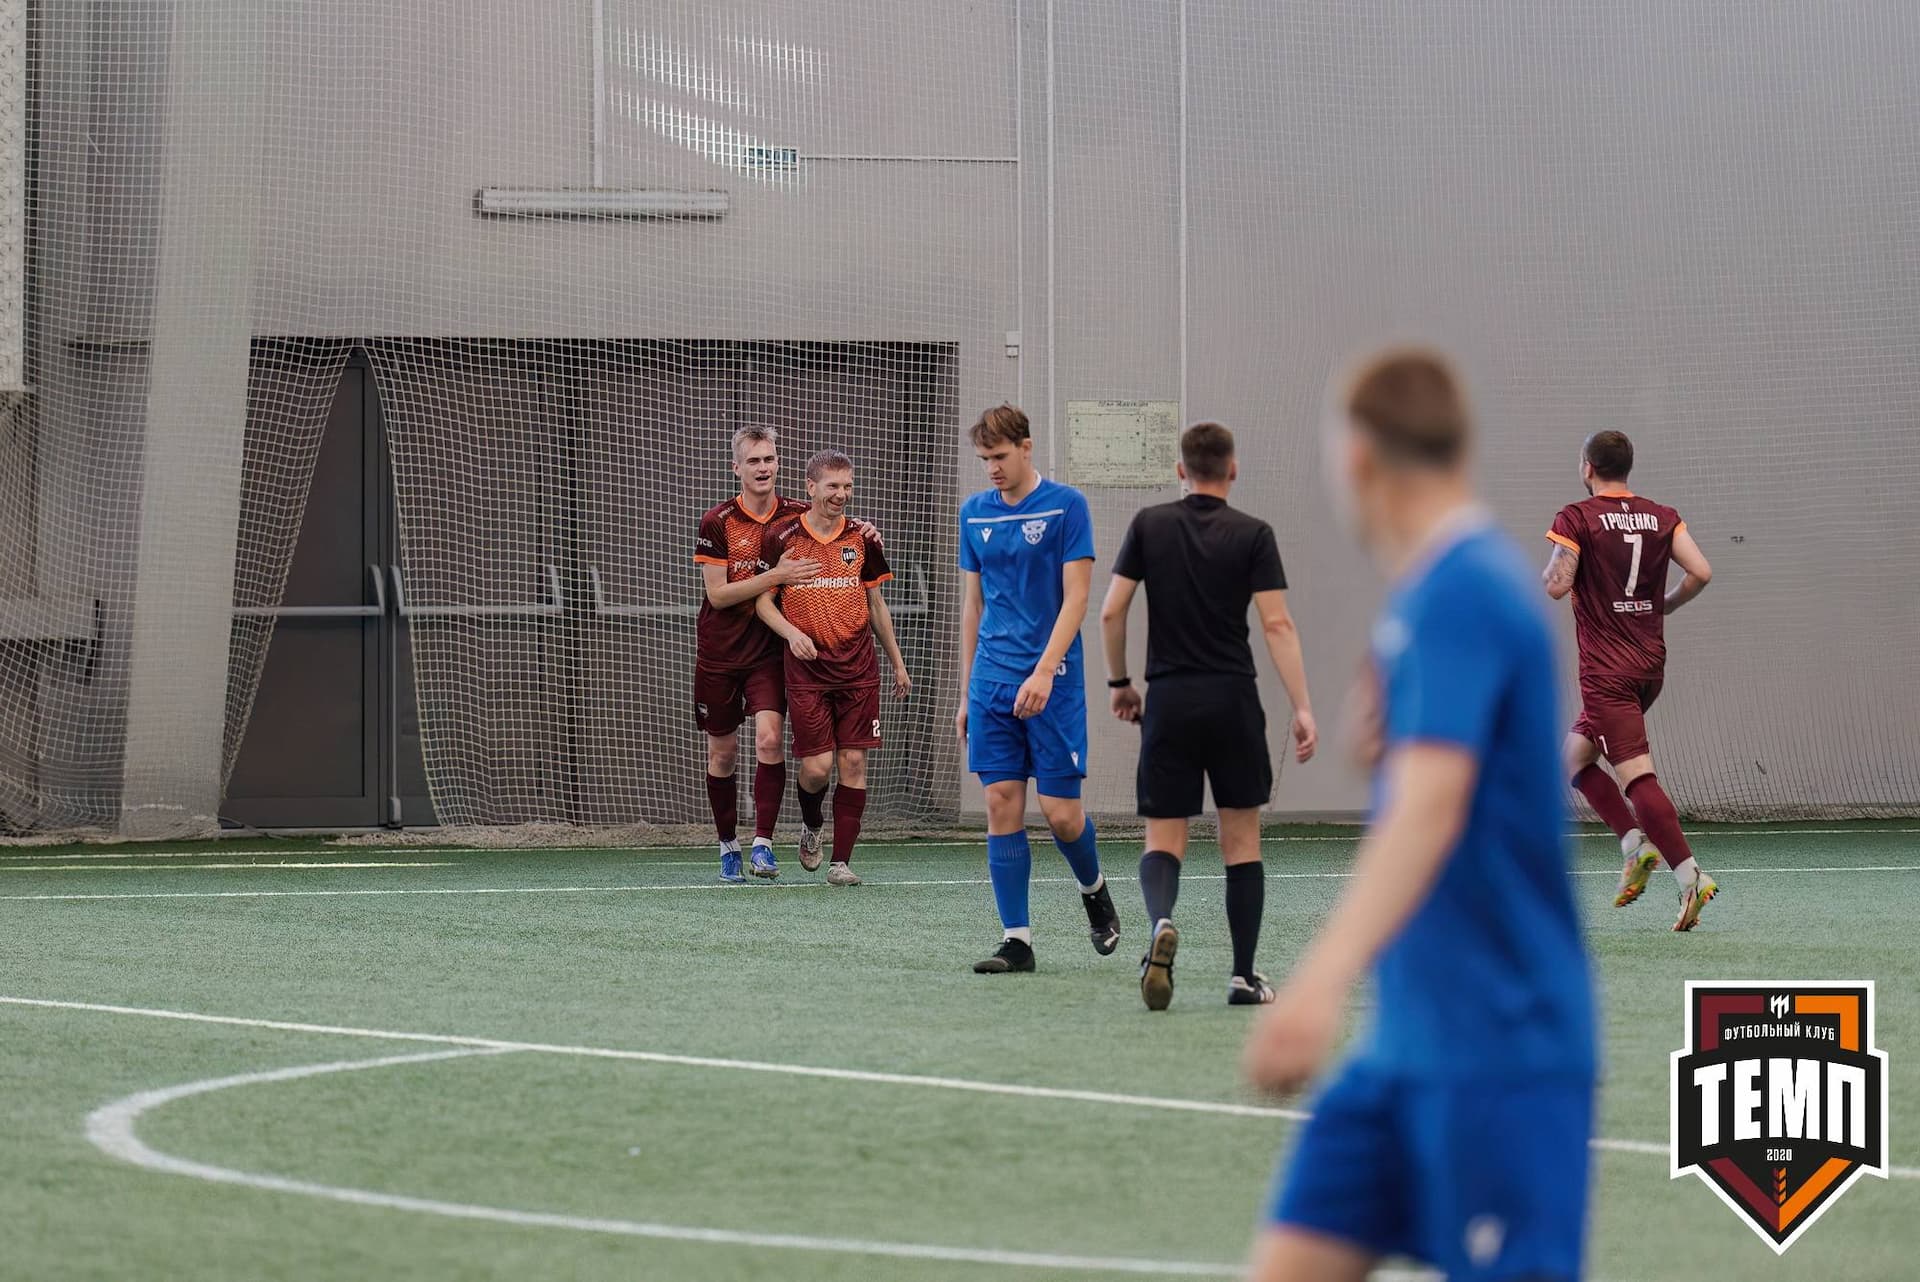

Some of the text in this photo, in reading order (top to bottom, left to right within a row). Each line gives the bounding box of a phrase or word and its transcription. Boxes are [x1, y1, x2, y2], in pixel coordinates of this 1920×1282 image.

[1599, 513, 1658, 532] ТРОЦЕНКО
[1623, 534, 1642, 597] 7
[872, 719, 880, 737] 2
